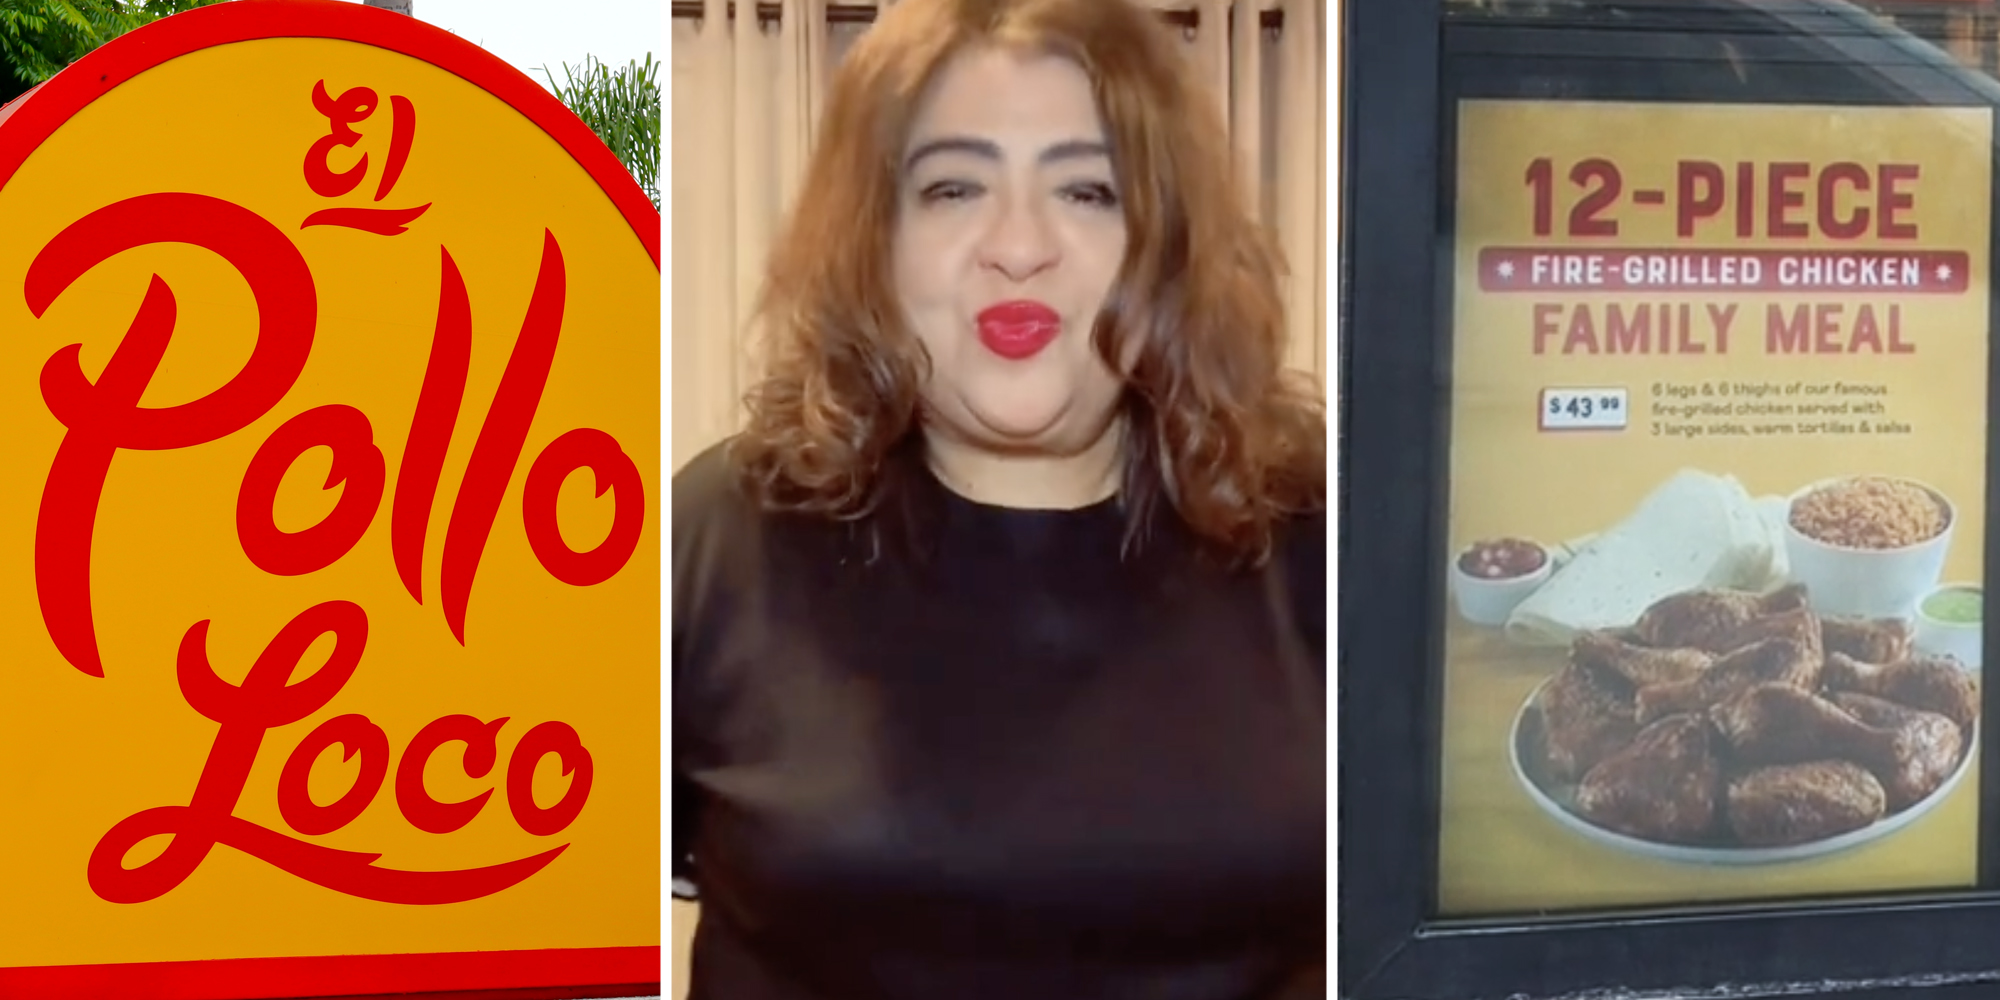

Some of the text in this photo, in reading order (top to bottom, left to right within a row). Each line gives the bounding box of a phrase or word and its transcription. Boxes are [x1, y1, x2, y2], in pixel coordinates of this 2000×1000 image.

[304, 79, 416, 202] El
[1524, 157, 1920, 240] 12-PIECE
[1531, 255, 1921, 287] FIRE-GRILLED CHICKEN
[1532, 303, 1916, 355] FAMILY MEAL
[1652, 382, 1887, 398] 6 legs & 6 thighs of our famous
[1652, 401, 1885, 418] fire-grilled chicken served with
[24, 192, 645, 678] Pollo
[1651, 421, 1912, 438] 3 large sides, warm tortillas & salsa
[87, 600, 594, 906] Loco
